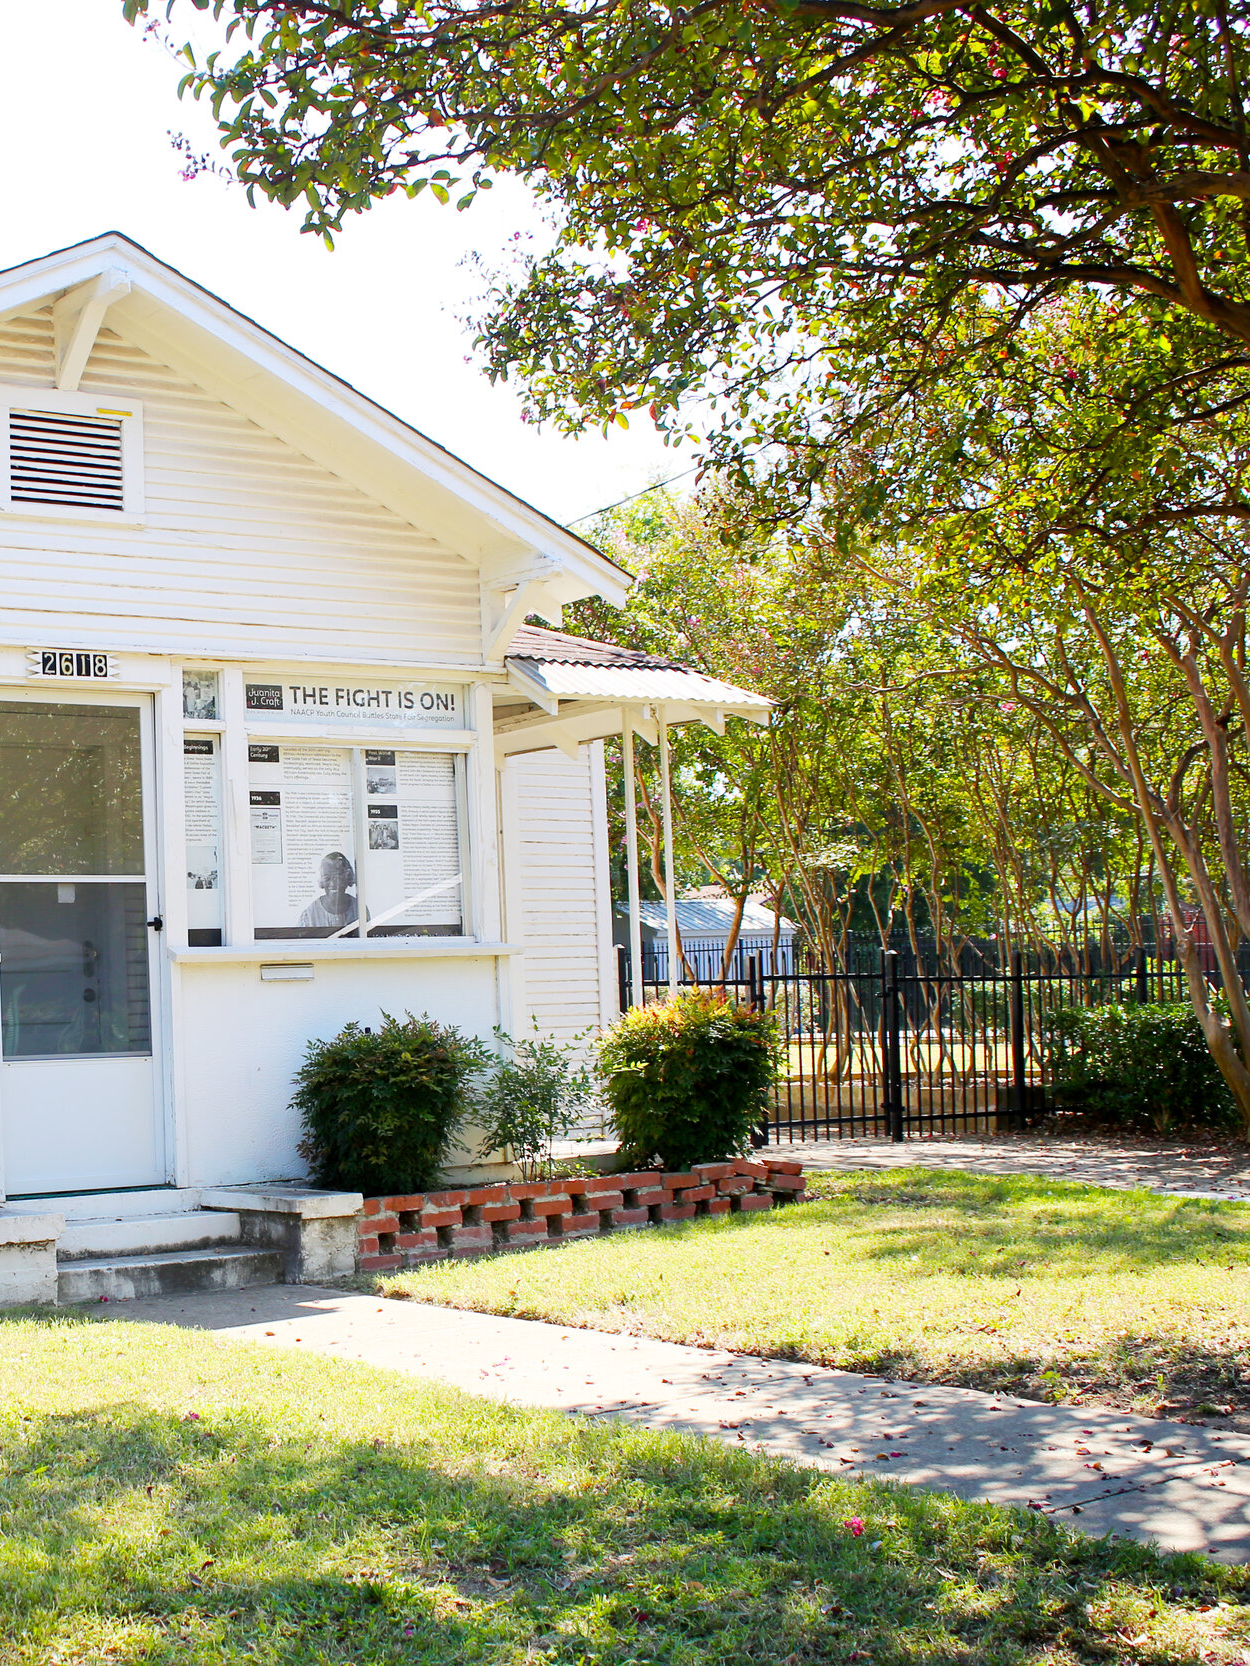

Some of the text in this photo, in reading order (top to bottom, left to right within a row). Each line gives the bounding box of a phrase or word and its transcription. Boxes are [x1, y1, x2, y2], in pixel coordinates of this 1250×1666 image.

[44, 653, 106, 676] 2618
[249, 688, 280, 697] Juanita
[261, 697, 280, 707] Craft
[289, 686, 455, 711] THE FIGHT IS ON!
[417, 714, 454, 722] Segregation
